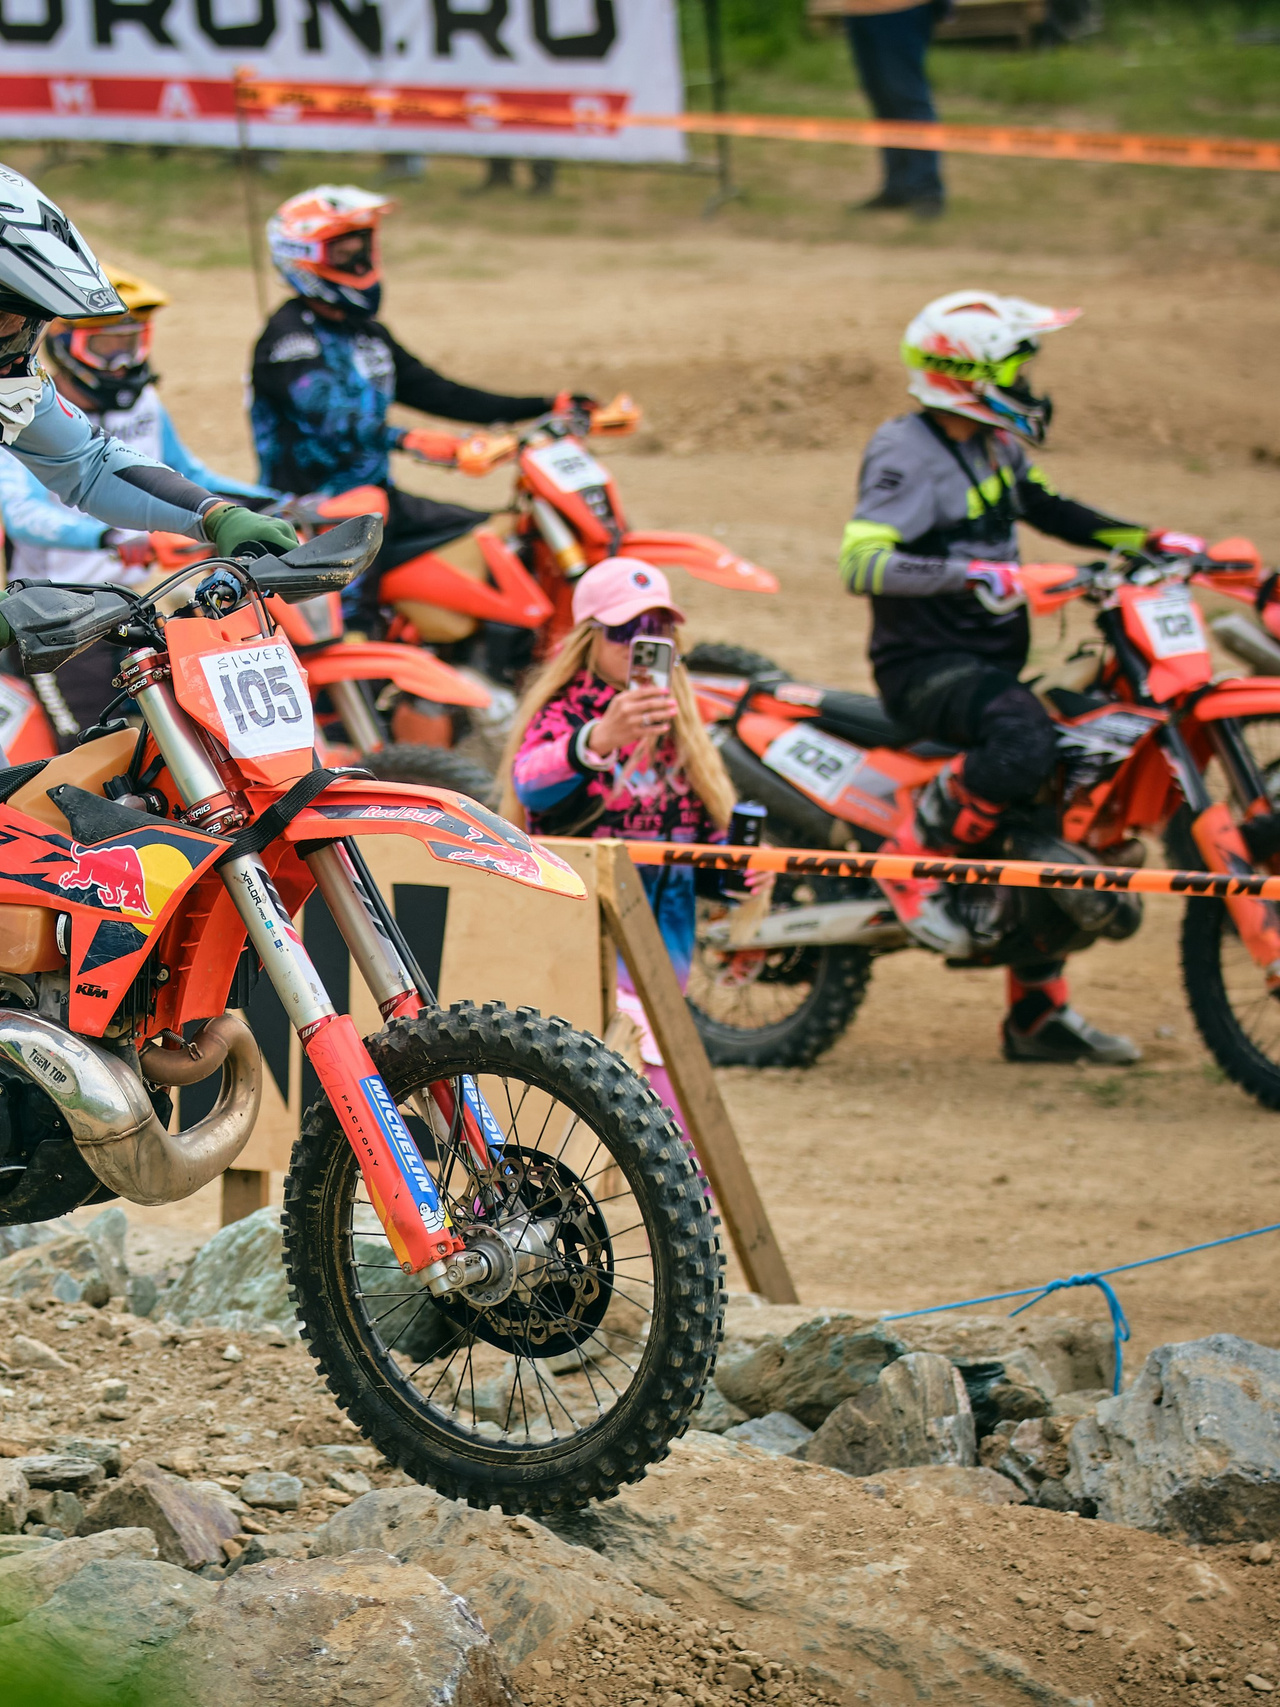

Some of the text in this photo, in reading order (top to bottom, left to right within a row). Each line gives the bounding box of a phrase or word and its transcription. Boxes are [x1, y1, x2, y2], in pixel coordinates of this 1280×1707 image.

[217, 645, 288, 671] SILVER
[219, 665, 303, 735] 105
[785, 738, 843, 781] 102
[360, 805, 445, 826] Red Bull
[240, 870, 262, 907] XPLOR
[75, 982, 109, 1000] KTM
[28, 1048, 68, 1085] TEEN TOP
[462, 1075, 504, 1145] ICHEL
[340, 1094, 380, 1168] FACTORY
[369, 1078, 433, 1194] MICHELIN
